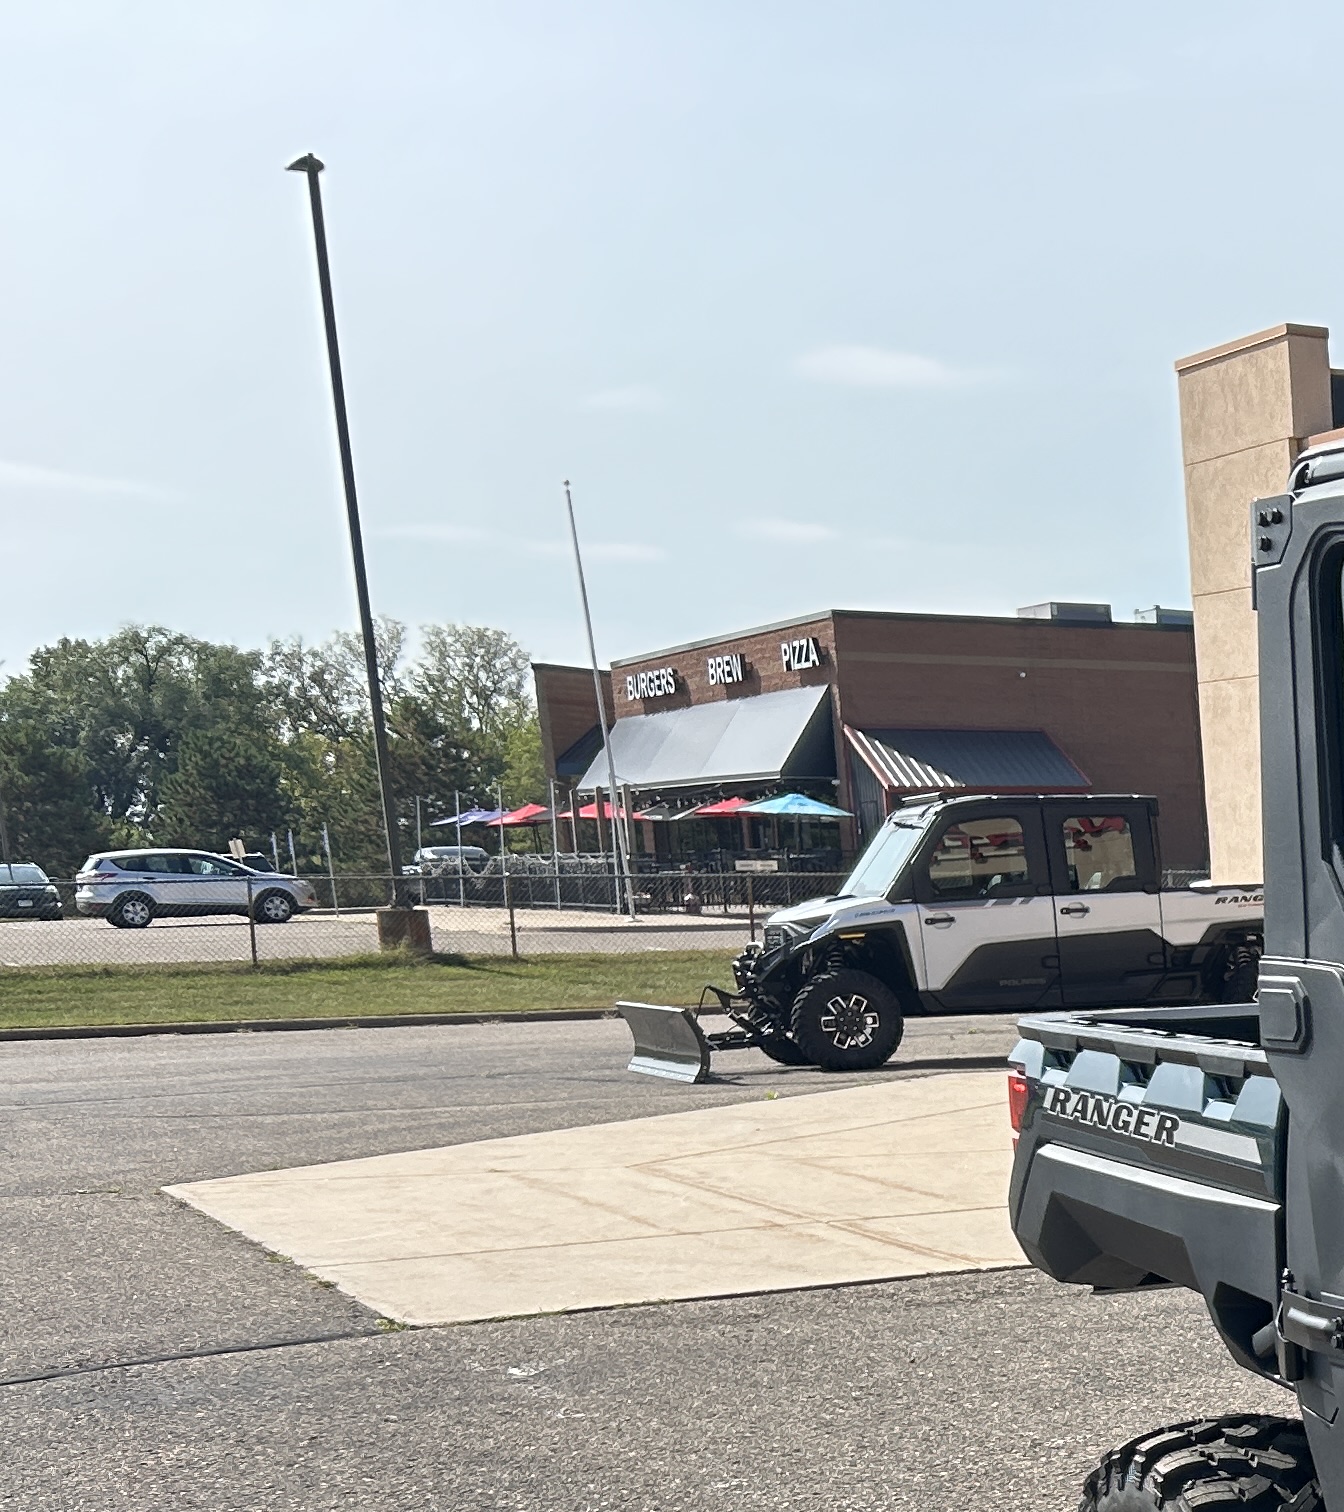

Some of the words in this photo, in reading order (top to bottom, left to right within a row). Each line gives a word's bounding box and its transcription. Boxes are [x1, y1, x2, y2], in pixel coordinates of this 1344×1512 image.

[626, 667, 676, 700] BURGERS
[707, 654, 743, 686] BREW
[781, 637, 820, 671] PIZZA
[1214, 894, 1263, 905] RANG
[1045, 1084, 1181, 1148] RANGER
